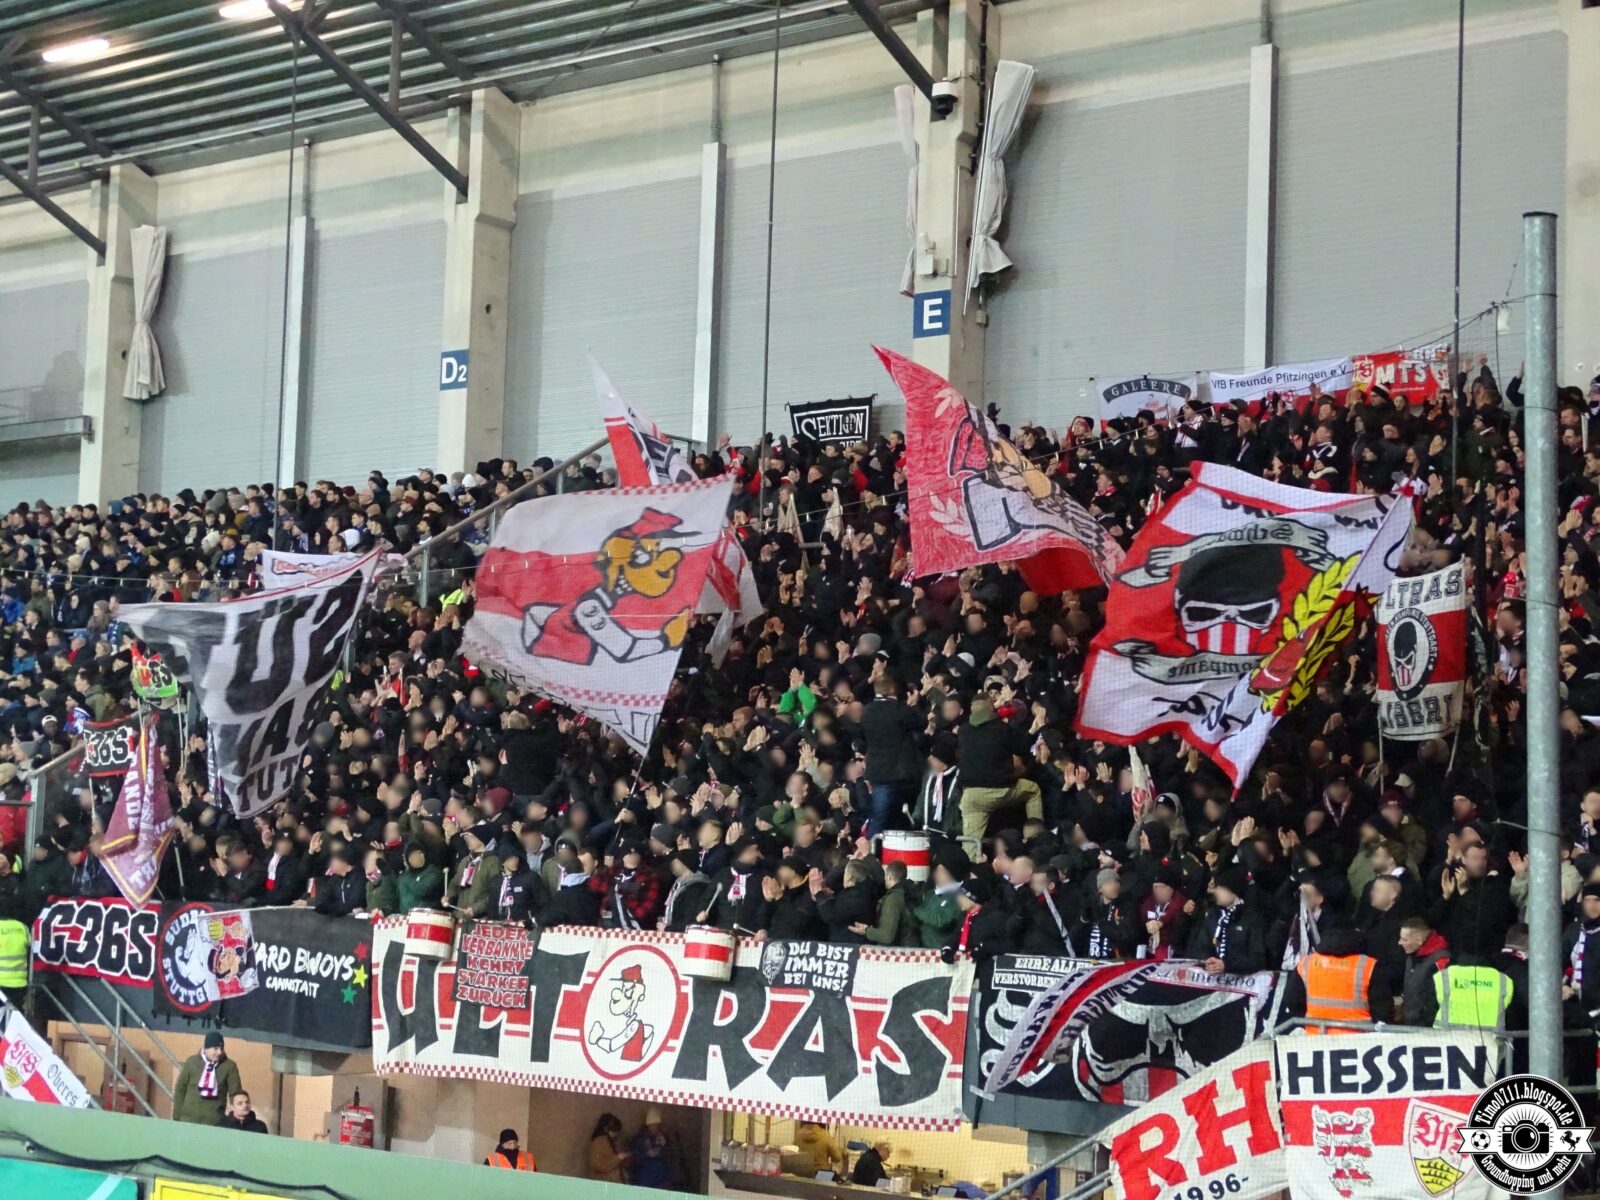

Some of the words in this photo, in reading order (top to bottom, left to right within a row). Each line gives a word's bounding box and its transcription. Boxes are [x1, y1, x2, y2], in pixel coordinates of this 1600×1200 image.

[923, 298, 943, 330] E
[441, 357, 467, 384] D2
[1229, 375, 1273, 388] Freunde
[1276, 369, 1327, 384] Pfitzingen
[1375, 362, 1427, 385] MTS
[1111, 380, 1181, 396] GALEERE
[471, 923, 530, 940] JEDER
[462, 934, 534, 960] VERBANNTE
[788, 941, 811, 956] DU
[816, 943, 853, 961] BIST
[294, 948, 356, 981] BWOYS
[466, 954, 525, 975] KEHRT
[784, 956, 850, 978] IMMER
[1015, 957, 1051, 971] EHRE
[265, 976, 320, 999] CANNSTATT
[784, 973, 807, 985] BEI
[812, 974, 848, 992] UNS!
[1287, 1045, 1487, 1095] HESSEN
